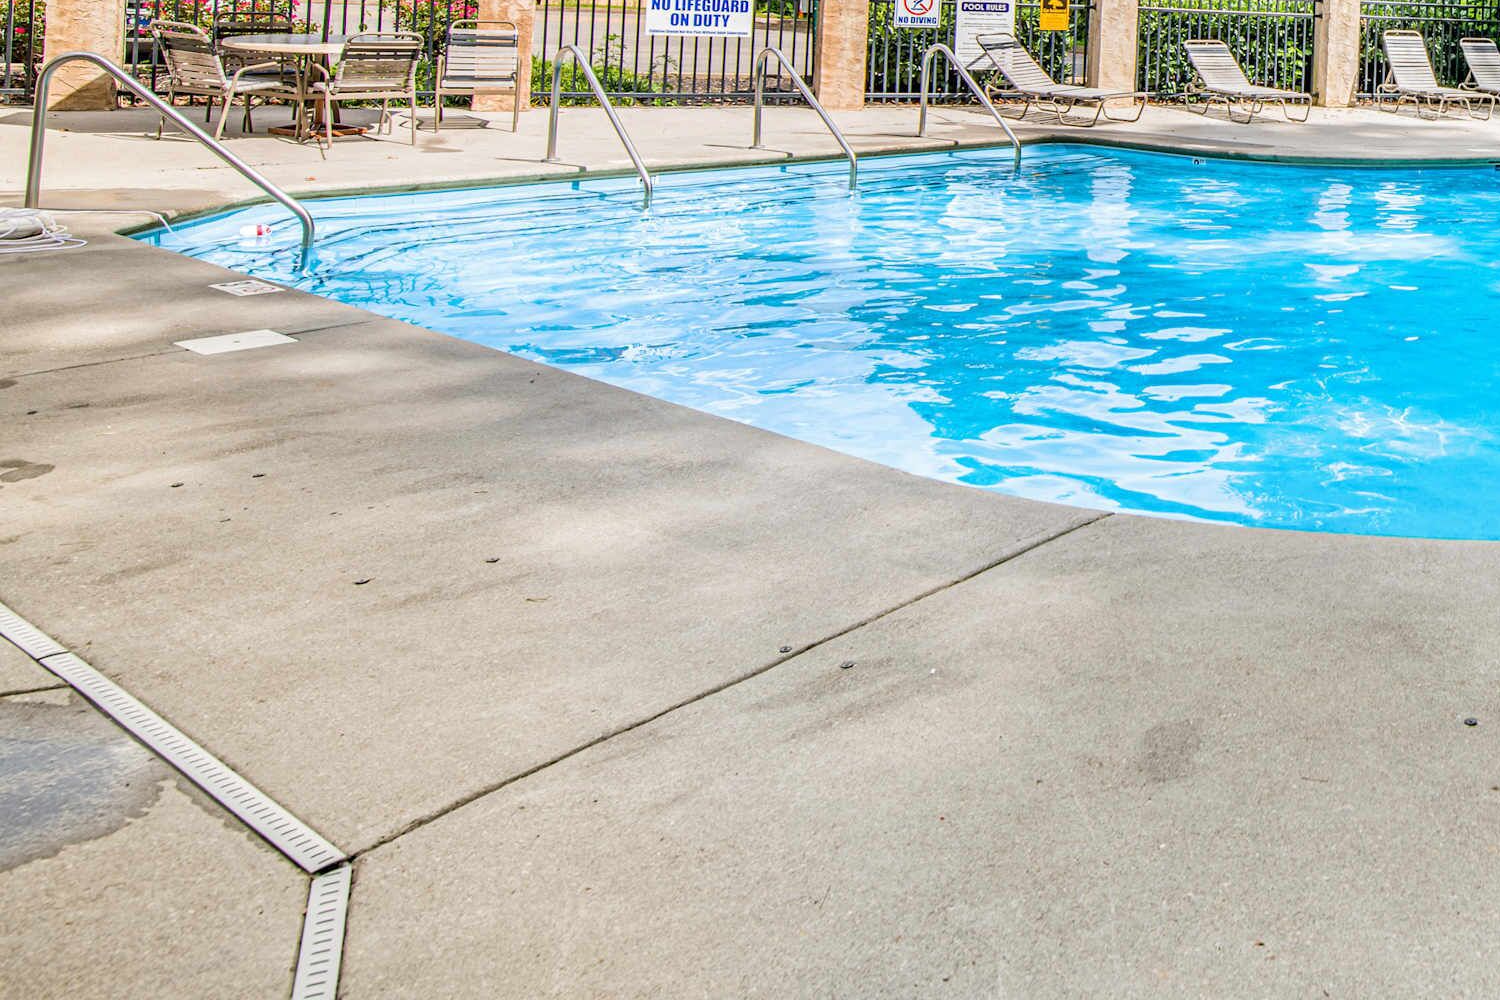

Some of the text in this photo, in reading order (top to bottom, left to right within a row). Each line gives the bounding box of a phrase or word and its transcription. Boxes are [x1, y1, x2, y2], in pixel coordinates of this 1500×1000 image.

[963, 3, 1007, 12] POOL RULES
[670, 13, 730, 27] ON DUTY
[898, 16, 937, 25] NO DIVING
